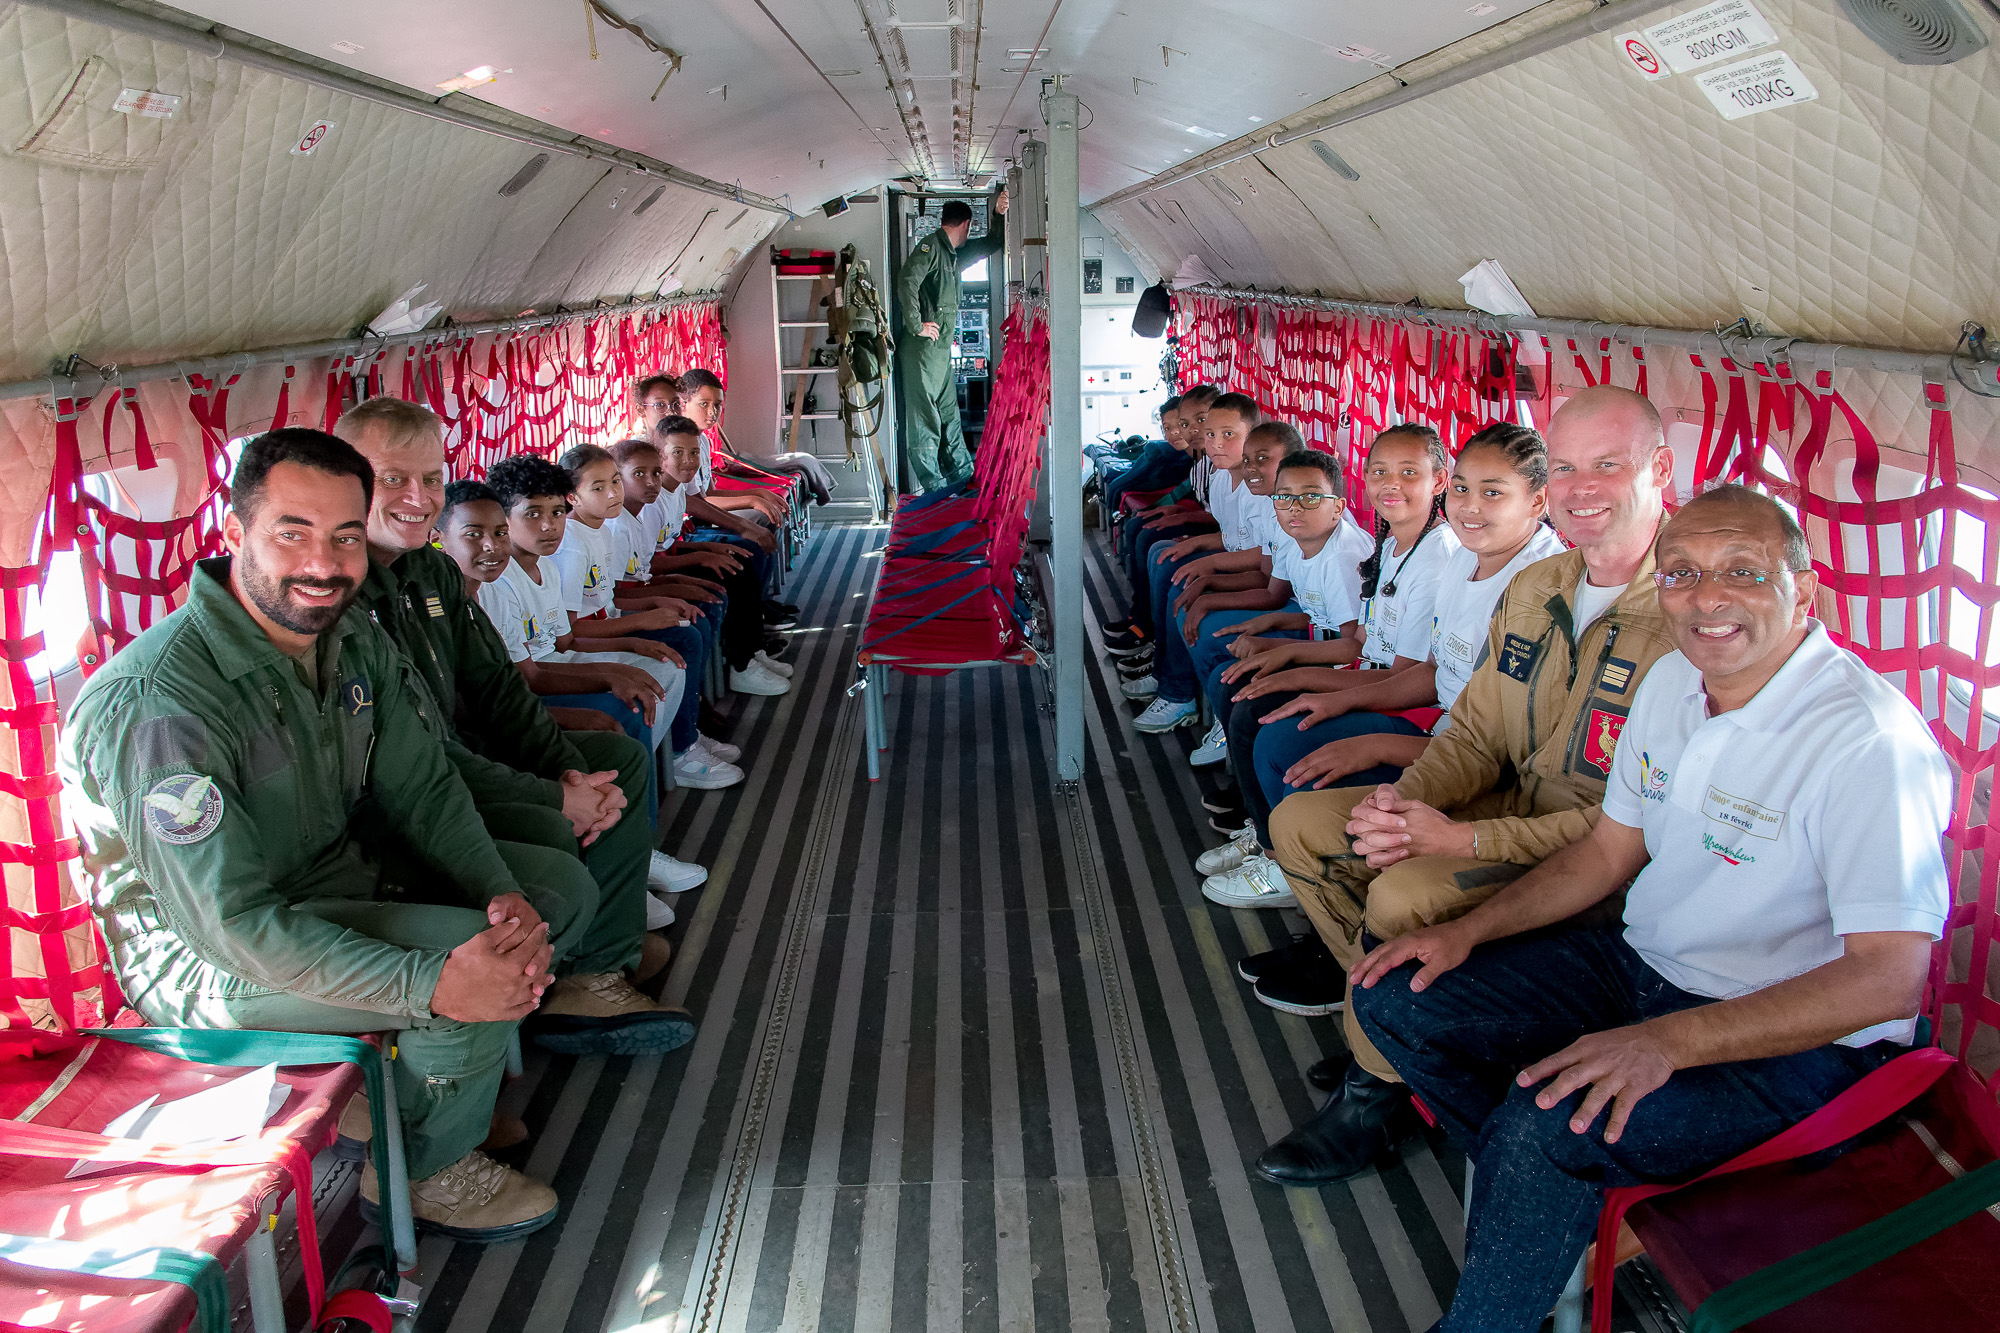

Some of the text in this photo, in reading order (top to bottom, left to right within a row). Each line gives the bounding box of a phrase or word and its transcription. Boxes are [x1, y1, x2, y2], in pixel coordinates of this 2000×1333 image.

[1659, 10, 1752, 47] SUR LE PLANCHER DE LA CABINE
[1679, 20, 1688, 29] DE
[1687, 11, 1713, 26] CHARGE
[1711, 0, 1744, 17] MAXIMALE
[1686, 27, 1751, 60] 800KG/M
[1703, 57, 1785, 87] CHARGE MAXIMALE PERMIS
[1715, 67, 1786, 92] EN VOL SUR LA RAMPE
[1731, 78, 1795, 108] 1000KG
[1719, 811, 1729, 820] 18
